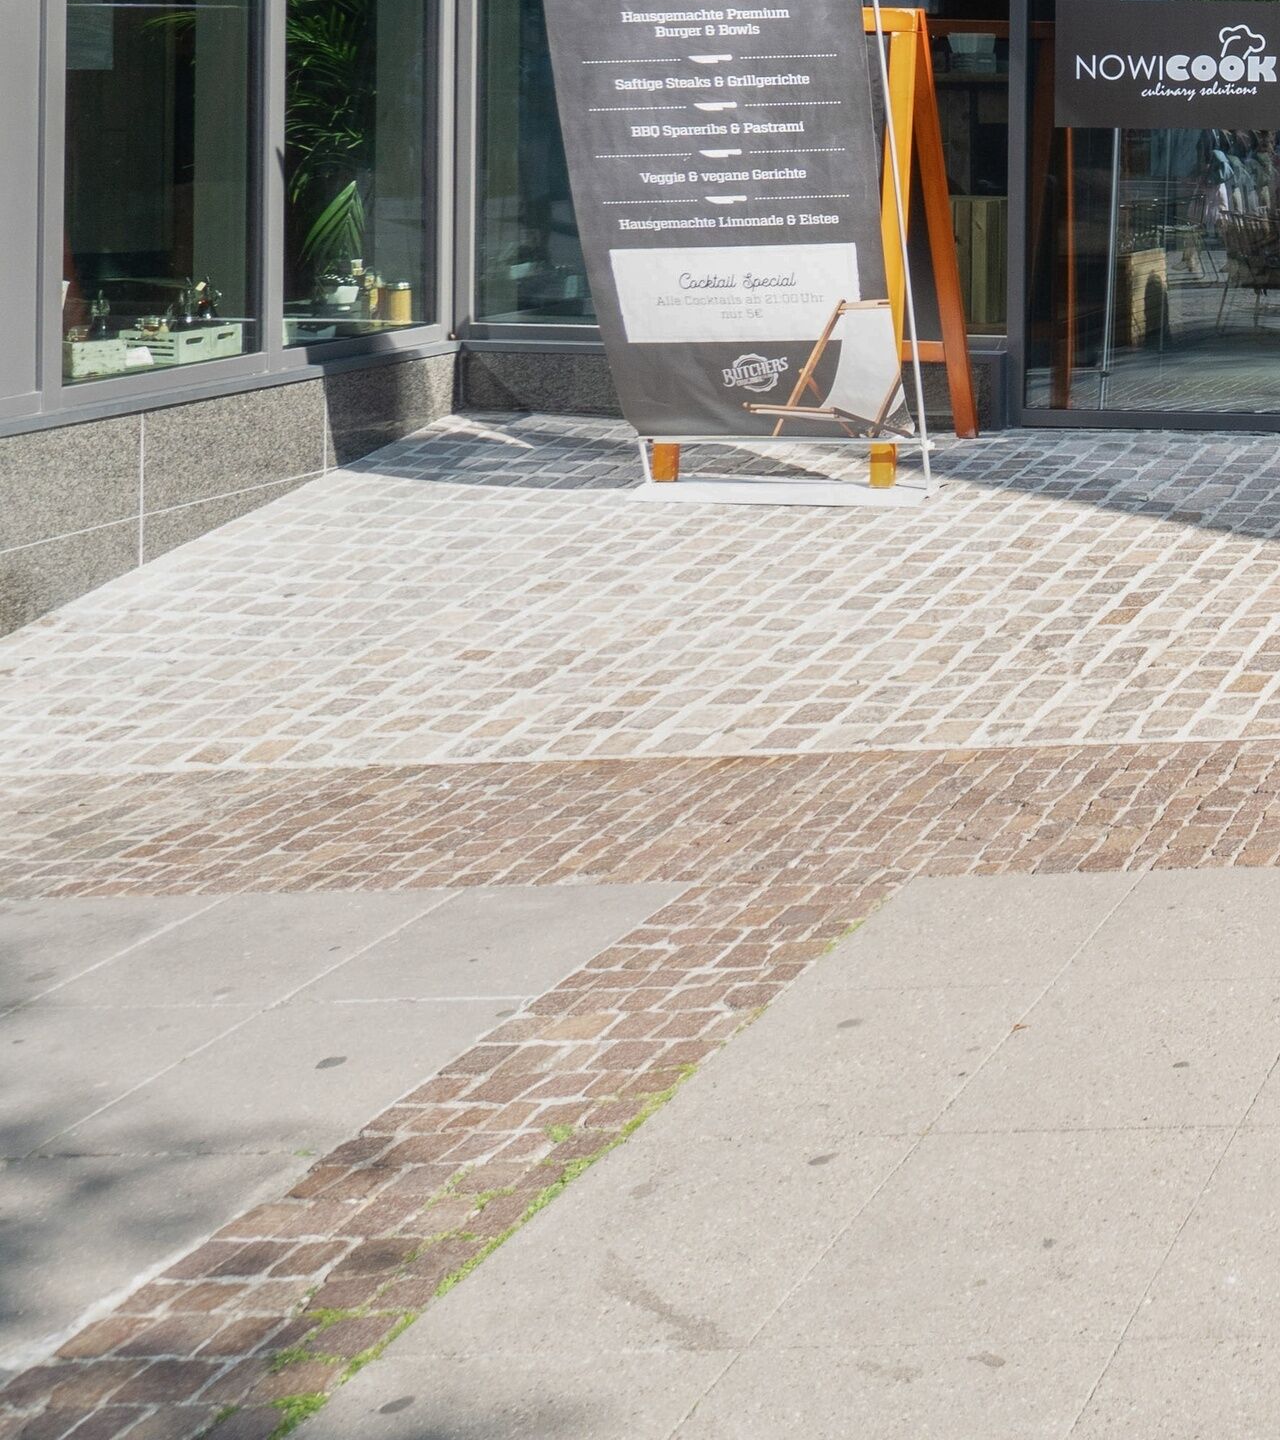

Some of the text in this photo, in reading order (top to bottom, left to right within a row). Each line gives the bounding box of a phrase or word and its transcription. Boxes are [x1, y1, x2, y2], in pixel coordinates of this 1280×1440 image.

[621, 8, 790, 25] Hausgemachte Premium
[654, 23, 760, 38] Burger & Bowls
[615, 74, 810, 92] Saftige Steaks & Grillgerichte
[1141, 81, 1257, 101] culinary solutions
[631, 121, 804, 138] BBQ Spareribs & Pastrami
[640, 168, 807, 185] Veggie & vegane Gerichte
[619, 213, 839, 231] Hausgemachte Limonade & Eistee
[678, 272, 797, 293] Cocktail Special
[656, 295, 682, 306] Alle
[684, 294, 742, 306] Cocktails
[745, 294, 762, 305] ab
[800, 293, 824, 304] Uhr
[720, 309, 744, 320] nur
[721, 356, 789, 388] BUTCHERS
